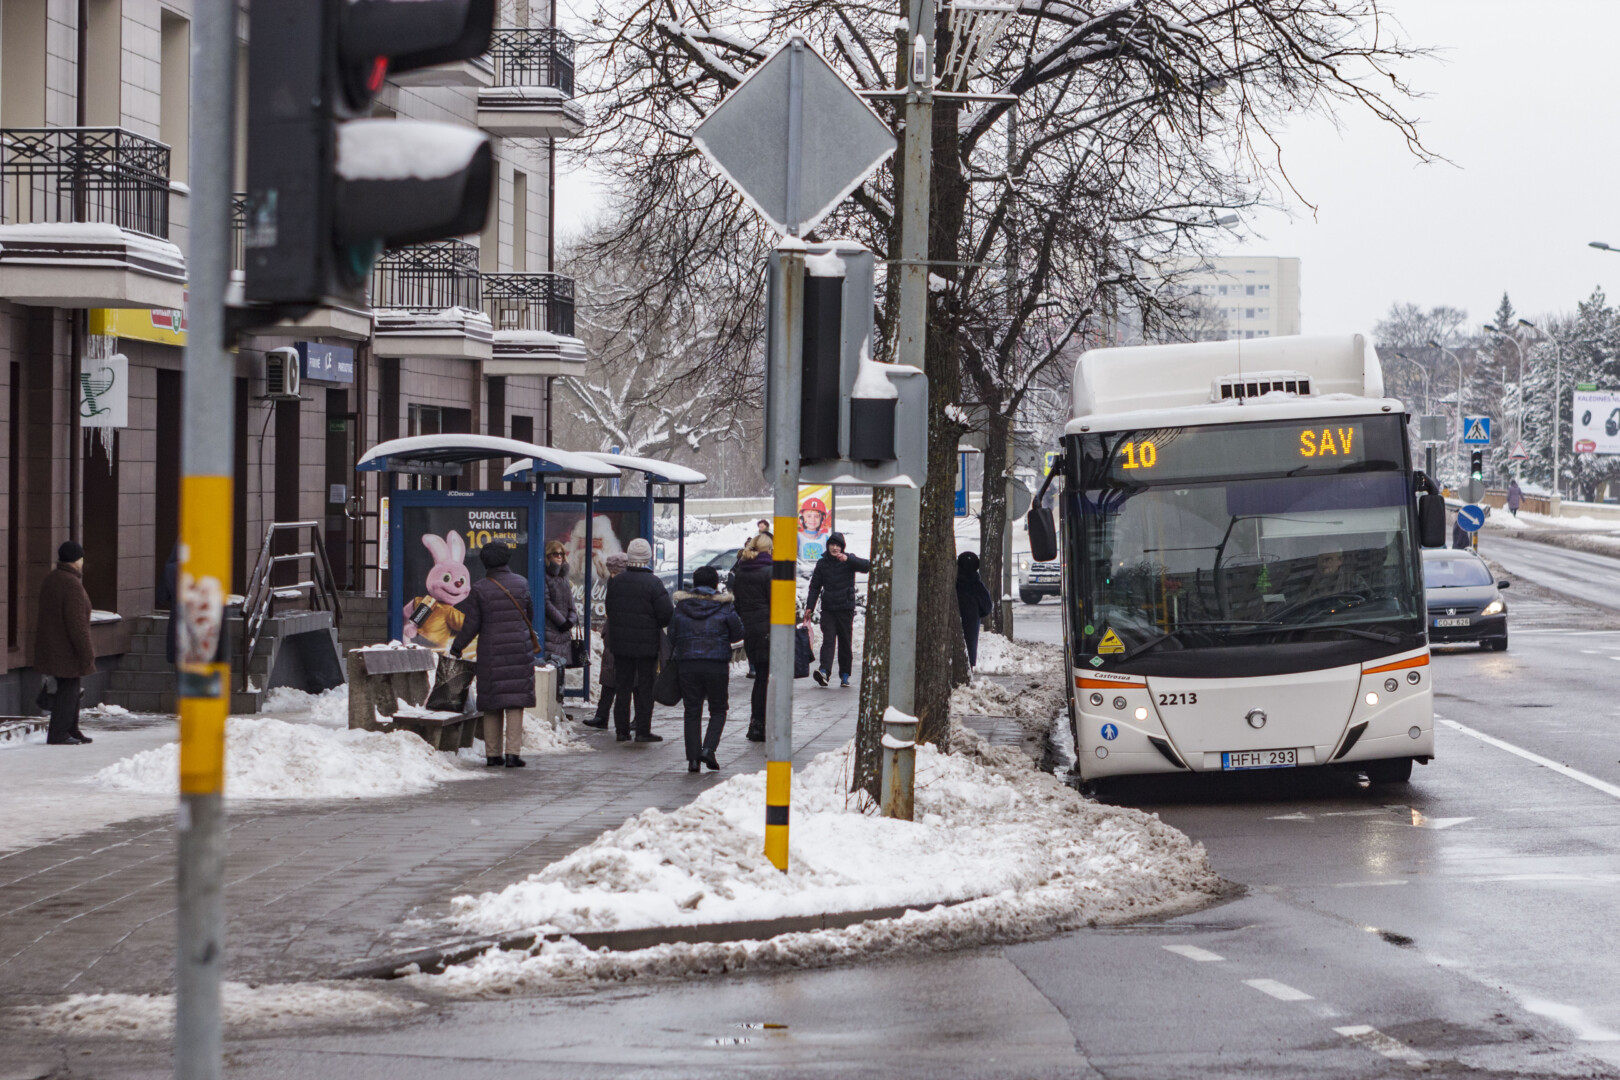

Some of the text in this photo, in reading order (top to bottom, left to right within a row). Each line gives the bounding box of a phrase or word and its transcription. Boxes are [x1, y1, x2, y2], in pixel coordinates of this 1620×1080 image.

[1300, 427, 1354, 457] SAV
[1122, 441, 1157, 469] 10
[468, 511, 517, 520] DURACELL
[468, 521, 517, 530] Veikia iki
[466, 530, 492, 549] 10
[1094, 672, 1131, 681] Castrosua
[1159, 692, 1198, 706] 2213
[1231, 751, 1295, 766] HFH 293
